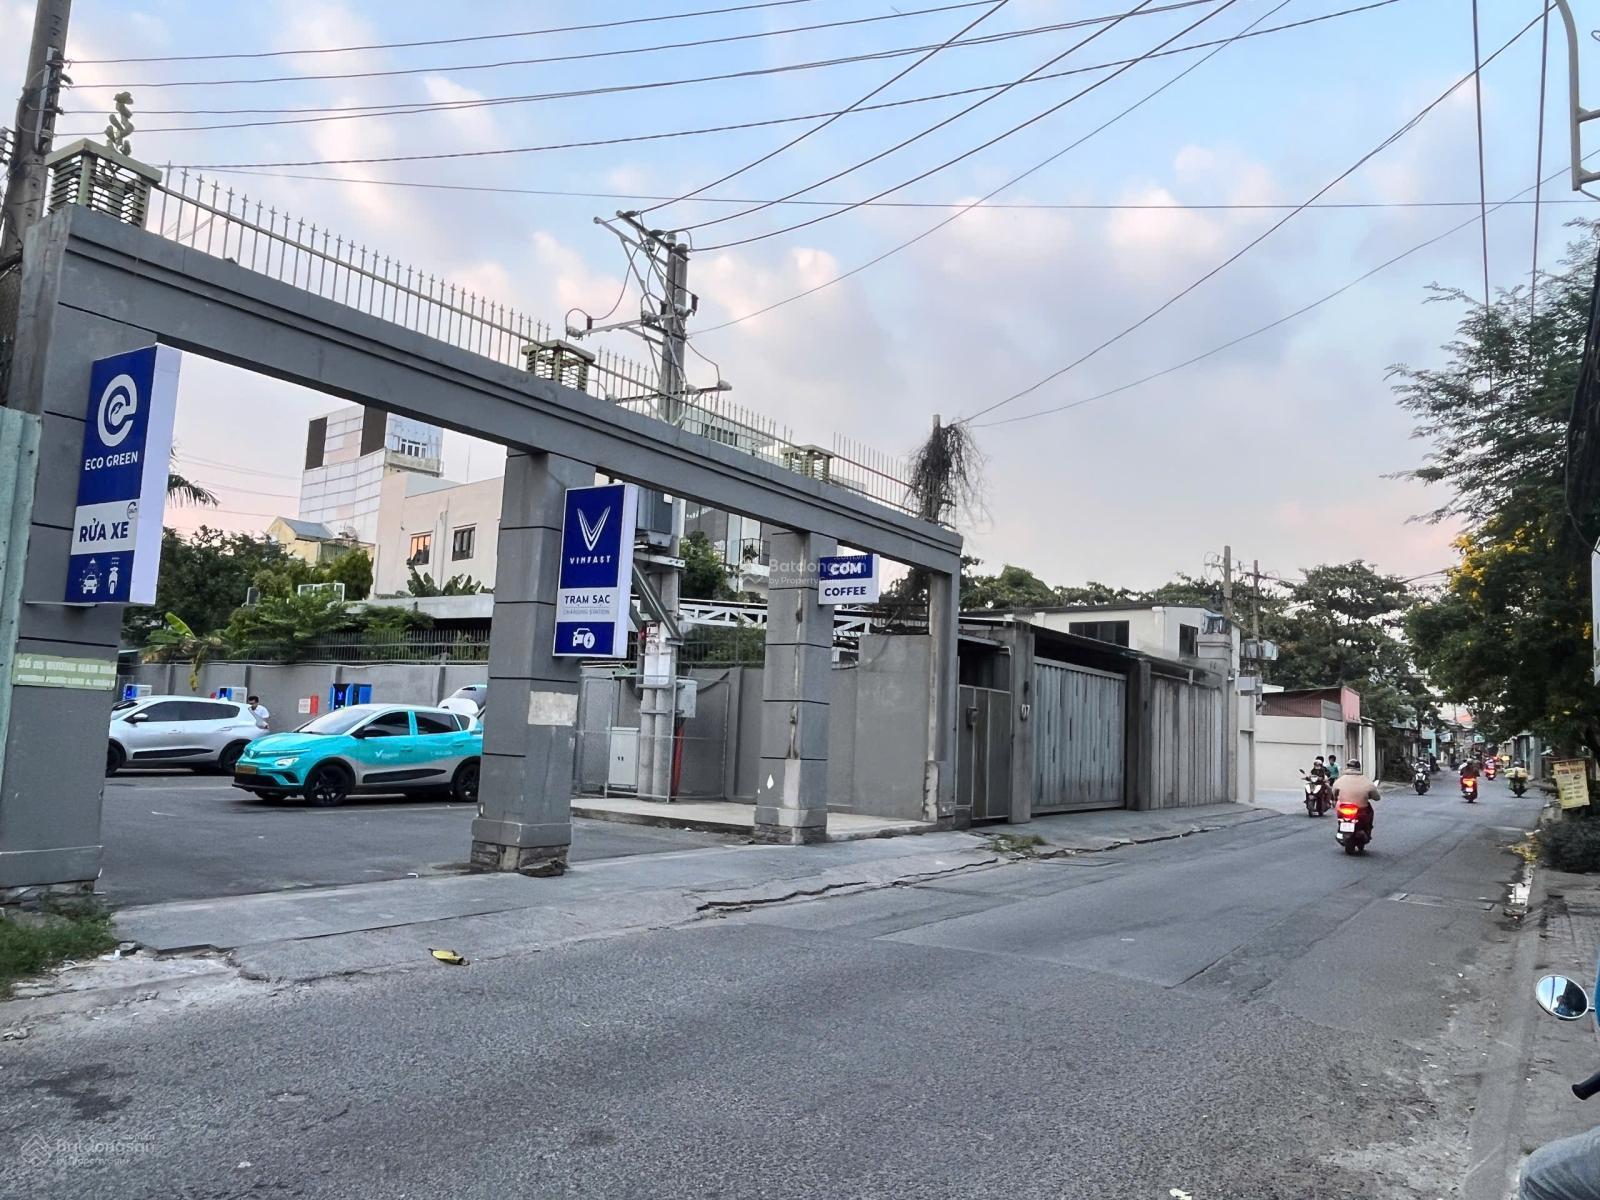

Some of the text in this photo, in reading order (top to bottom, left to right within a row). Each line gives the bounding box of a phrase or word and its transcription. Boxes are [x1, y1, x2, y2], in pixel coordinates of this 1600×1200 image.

[84, 450, 138, 471] ECO GREEN
[79, 518, 129, 542] RỬA XE
[570, 555, 611, 565] VINFAST
[830, 561, 862, 576] CƠM
[824, 586, 867, 597] COFFEE
